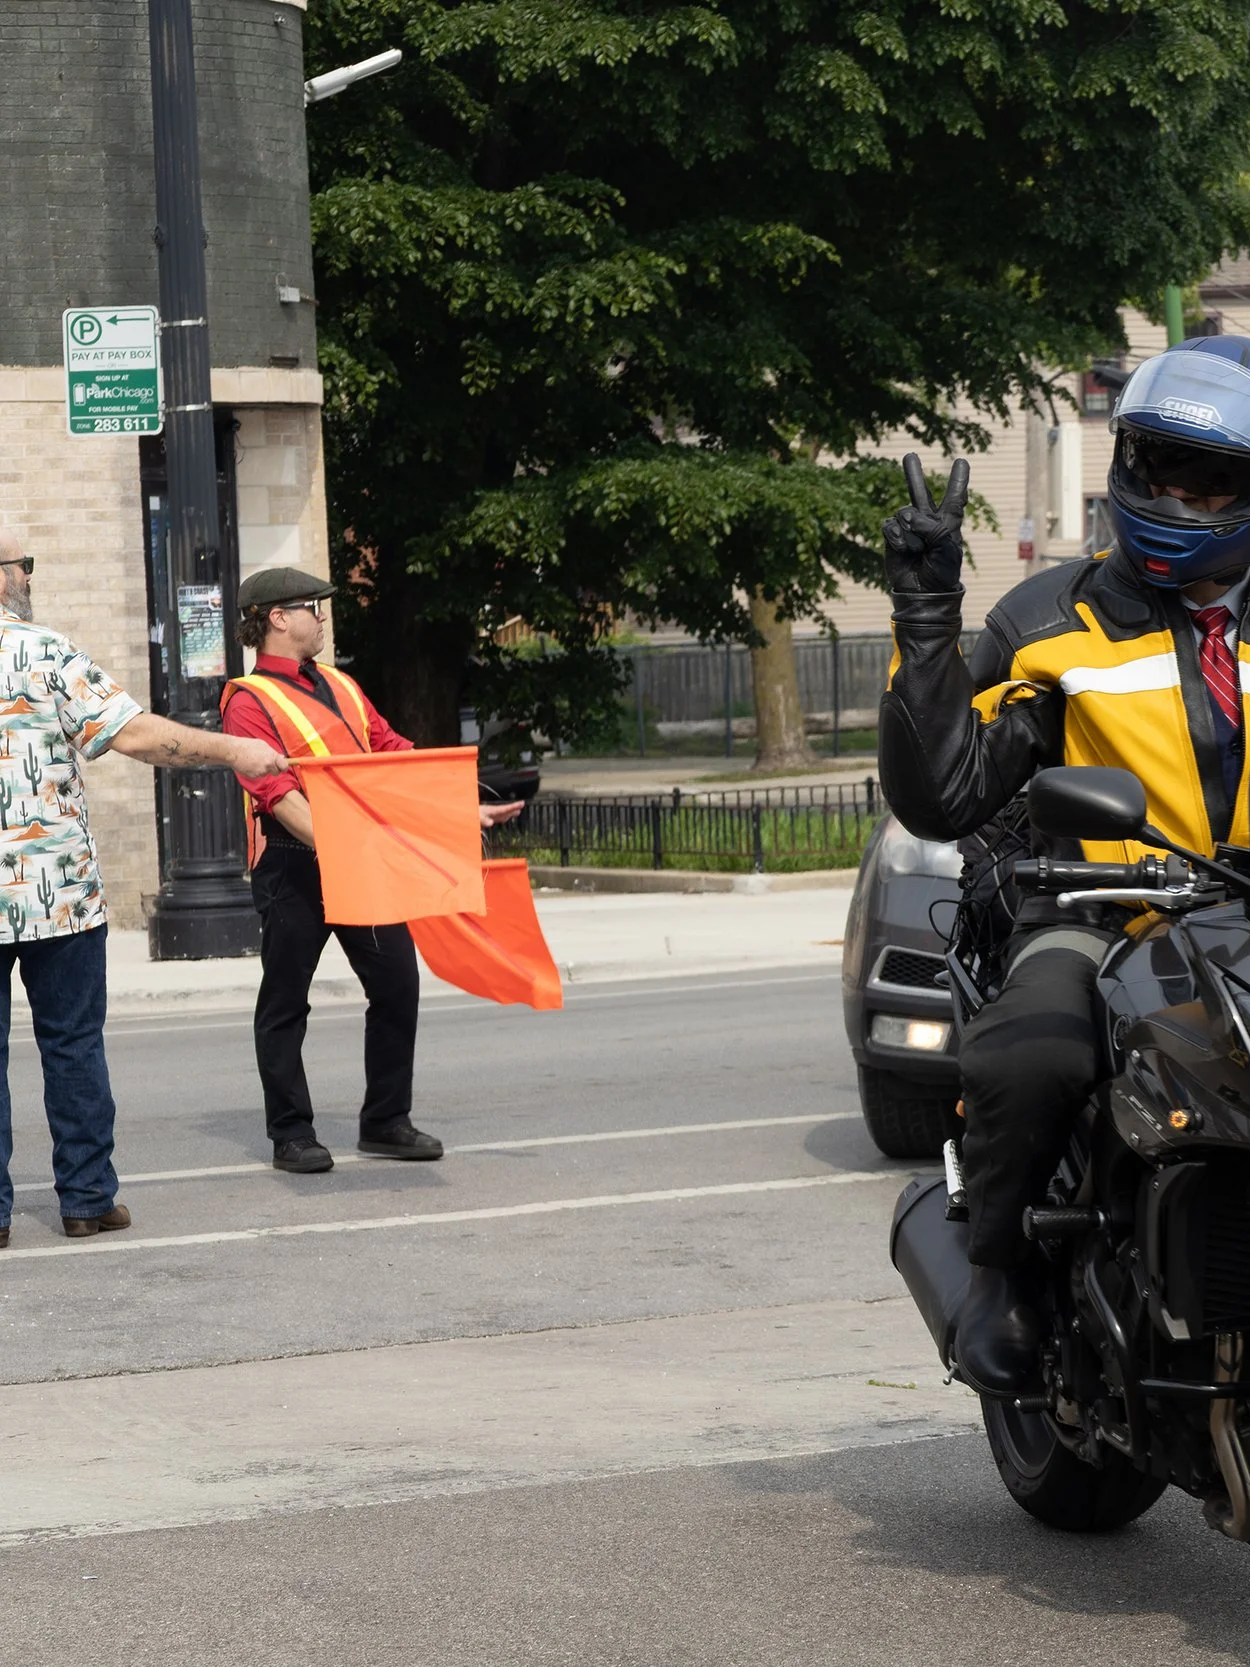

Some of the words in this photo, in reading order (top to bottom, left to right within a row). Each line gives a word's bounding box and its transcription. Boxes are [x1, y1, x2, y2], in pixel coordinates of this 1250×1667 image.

[72, 352, 91, 361] PAY
[92, 351, 105, 361] AT
[108, 351, 126, 360] PAY
[130, 350, 152, 359] BOX
[95, 374, 111, 382] SIGN
[86, 386, 154, 399] ParkChicago
[102, 405, 126, 413] MOBILE
[1162, 400, 1216, 426] SHOEI
[94, 418, 120, 432] 283
[123, 417, 148, 431] 611
